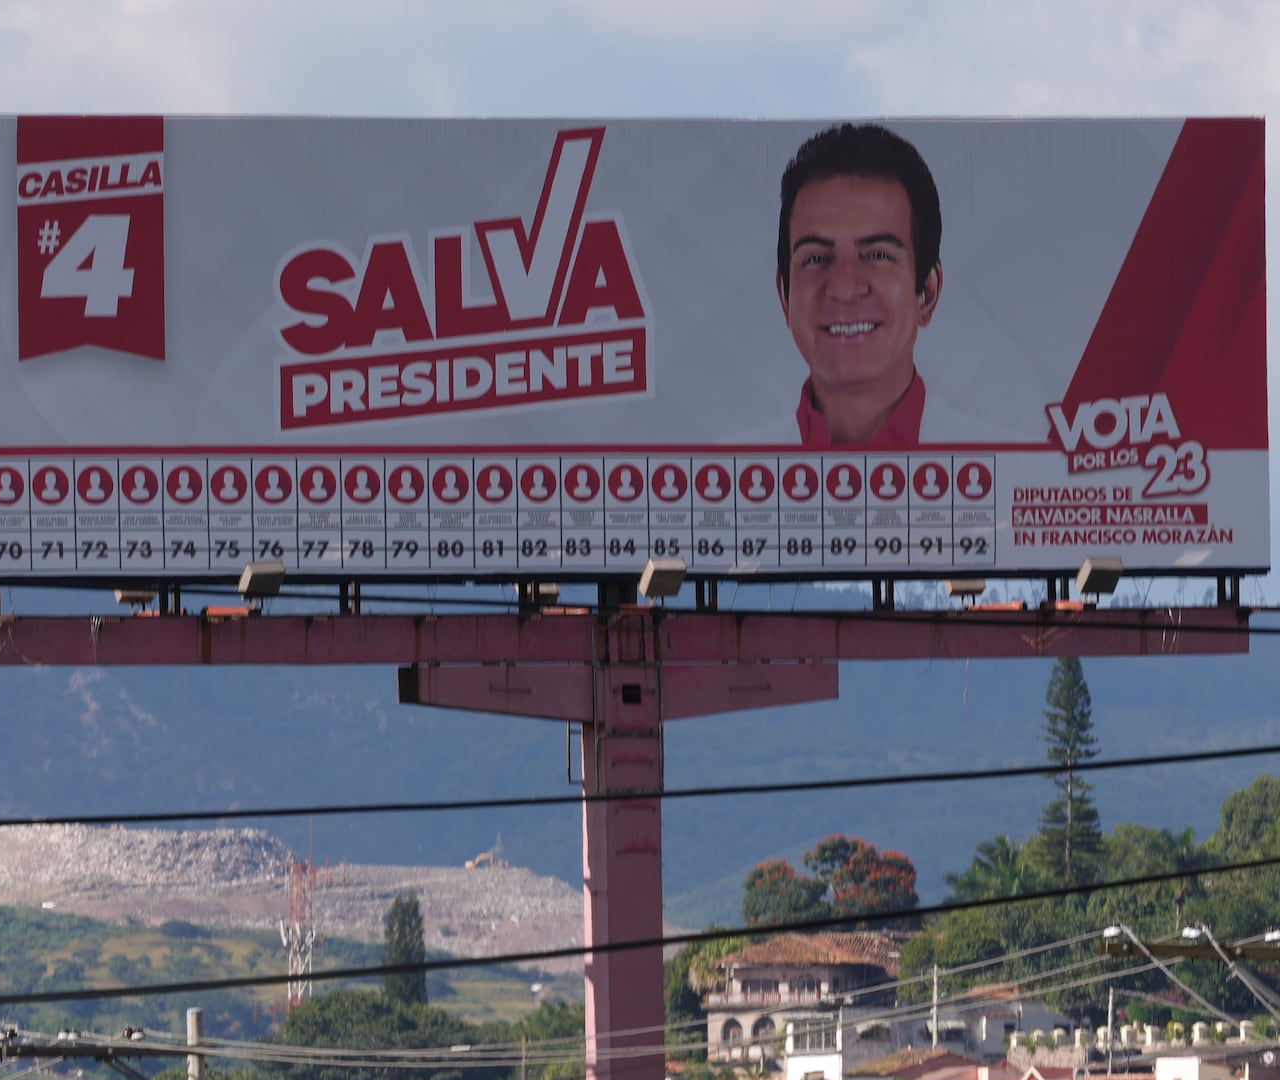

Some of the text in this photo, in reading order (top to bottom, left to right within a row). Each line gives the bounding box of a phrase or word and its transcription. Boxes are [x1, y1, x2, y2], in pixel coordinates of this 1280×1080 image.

[19, 161, 162, 198] CASILLA
[280, 126, 645, 355] SALVA
[292, 338, 634, 418] PRESIDENTE
[1049, 393, 1181, 452] VOTA
[1073, 449, 1139, 471] POR LOS
[1144, 441, 1208, 496] 23
[1013, 487, 1133, 503] DIPUTADOS DE
[1013, 506, 1195, 525] SALVADOR NASRALLA
[41, 541, 64, 559] 71
[81, 541, 108, 558] 72
[127, 541, 152, 558] 73
[171, 541, 196, 558] 74
[215, 541, 240, 558] 75
[259, 540, 284, 558] 76
[303, 541, 329, 558] 77
[349, 540, 375, 558] 78
[392, 541, 419, 558] 79
[437, 540, 464, 558] 80
[482, 540, 504, 557] 81
[521, 539, 548, 556] 82
[566, 538, 591, 556] 83
[609, 538, 636, 556] 84
[654, 538, 680, 556] 85
[697, 538, 725, 556] 86
[742, 538, 767, 556] 87
[786, 538, 813, 555] 88
[830, 537, 857, 555] 89
[874, 537, 902, 554] 90
[920, 537, 943, 554] 91
[960, 537, 987, 554] 92
[1013, 524, 1234, 546] EN FRANCISCO MORAZÁN
